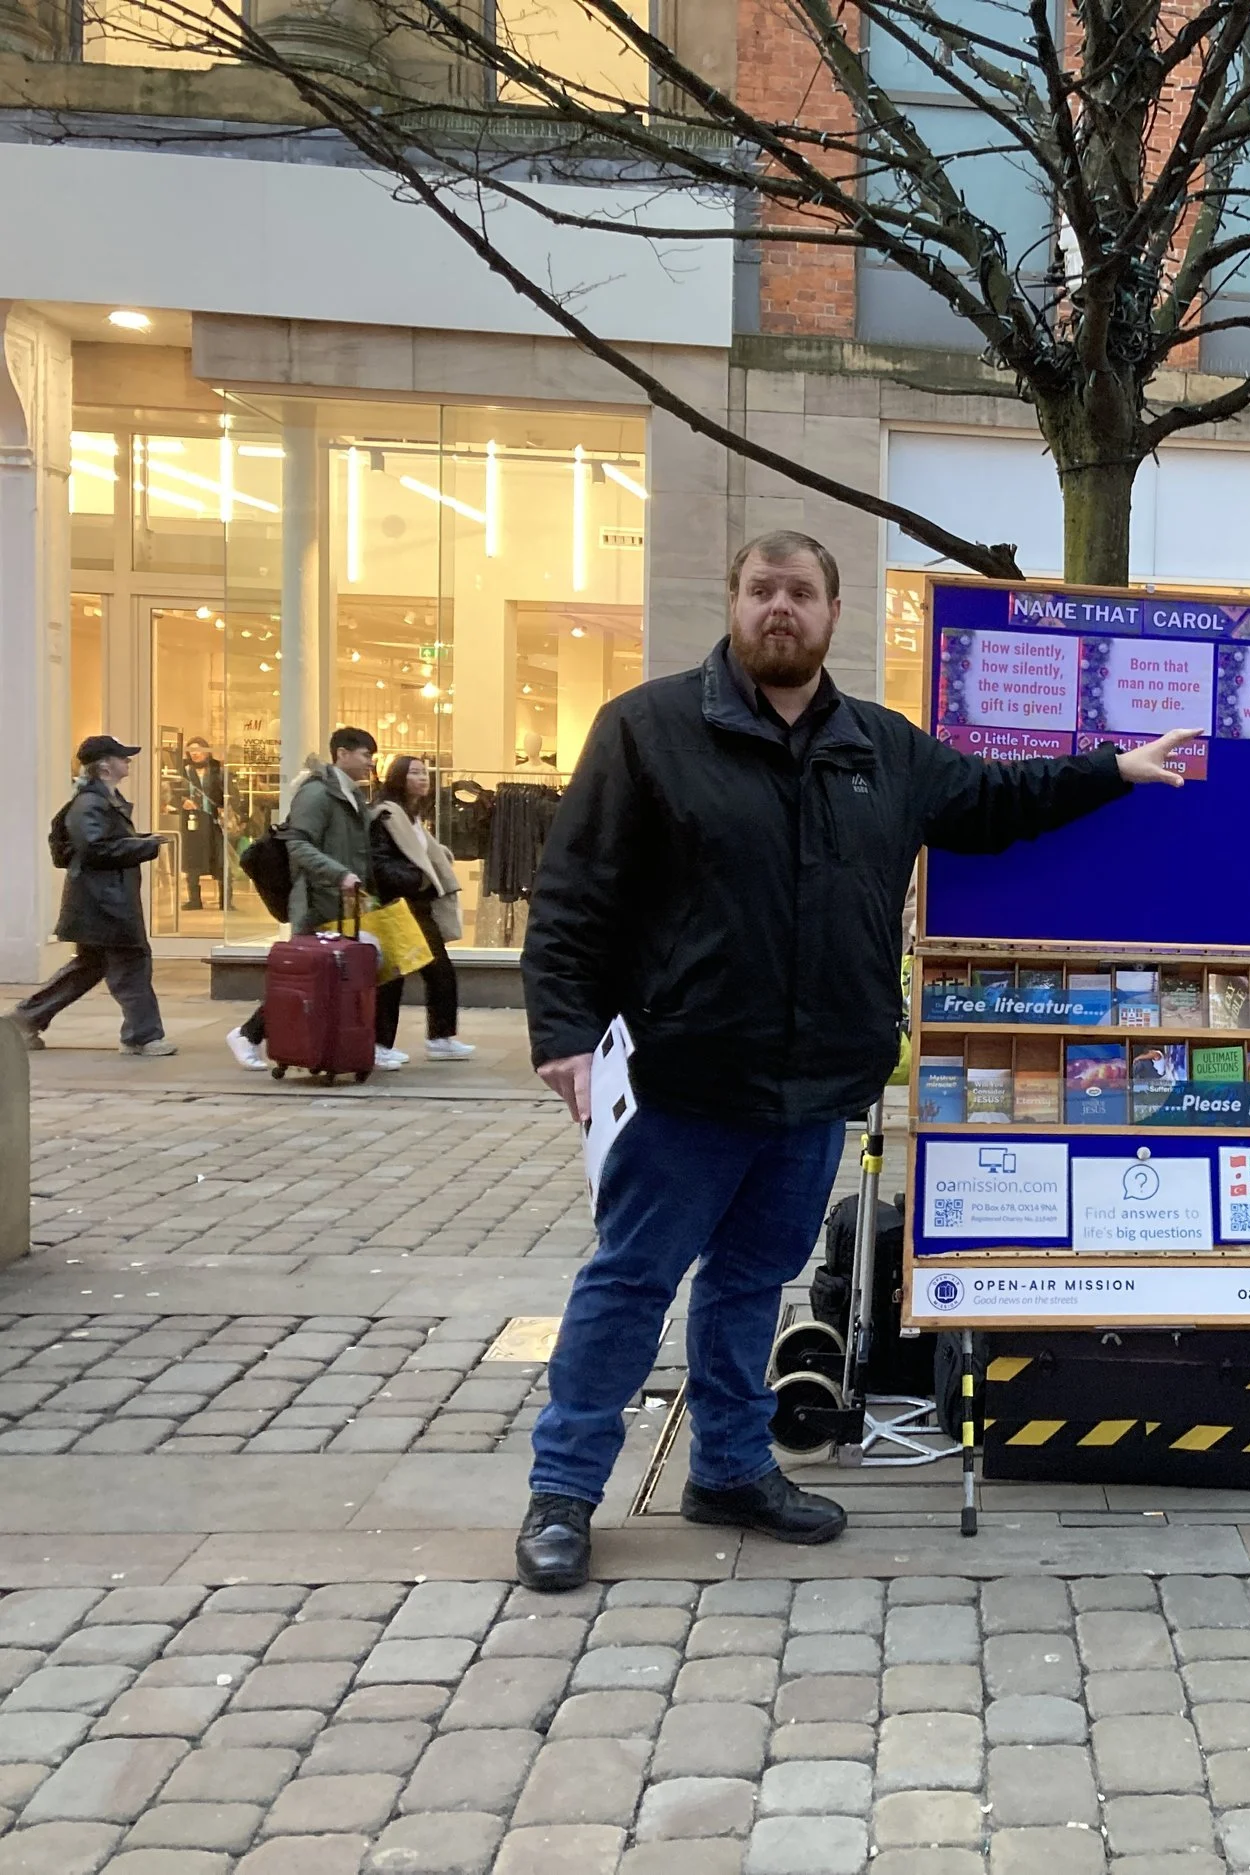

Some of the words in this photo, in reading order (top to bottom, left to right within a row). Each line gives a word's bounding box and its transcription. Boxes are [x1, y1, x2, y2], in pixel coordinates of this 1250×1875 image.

[1014, 599, 1077, 620] NAME
[1082, 603, 1139, 624] THAT
[1153, 610, 1224, 631] CAROL
[981, 640, 1010, 655] How
[1014, 642, 1065, 661] silently,
[982, 660, 1008, 673] how
[1012, 661, 1064, 680] silently,
[1130, 658, 1160, 672] Born
[1164, 660, 1189, 673] that
[978, 679, 1000, 692] the
[1003, 681, 1066, 696] wondrous
[1118, 678, 1145, 690] man
[1148, 680, 1164, 691] no
[1168, 681, 1200, 693] more
[981, 698, 1004, 714] gift
[1007, 700, 1019, 713] is
[1023, 700, 1063, 716] given!
[1131, 699, 1158, 712] may
[1161, 697, 1185, 711] die.
[243, 738, 282, 746] WOMEN
[969, 730, 981, 743] O
[984, 732, 1019, 746] Little
[1022, 734, 1060, 748] Town
[943, 995, 986, 1013] Free
[1202, 1051, 1239, 1064] ULTIMATE
[1196, 1062, 1240, 1074] QUESTIONS
[936, 1177, 1058, 1193] oamission.com
[971, 1203, 983, 1212] PO
[985, 1203, 998, 1212] Box
[1017, 1203, 1039, 1212] OX14
[1040, 1203, 1058, 1212] 9NA
[1085, 1207, 1116, 1219] Find
[1121, 1209, 1180, 1219] answers
[1185, 1208, 1200, 1219] to
[1084, 1226, 1113, 1239] life's
[1116, 1226, 1137, 1241] big
[1140, 1226, 1202, 1241] questions
[973, 1279, 1057, 1291] OPEN-AIR
[1064, 1279, 1136, 1291] MISSION
[973, 1295, 996, 1305] Good
[998, 1297, 1019, 1305] news
[1021, 1297, 1032, 1305] on
[1034, 1296, 1049, 1305] the
[1050, 1296, 1078, 1305] streets
